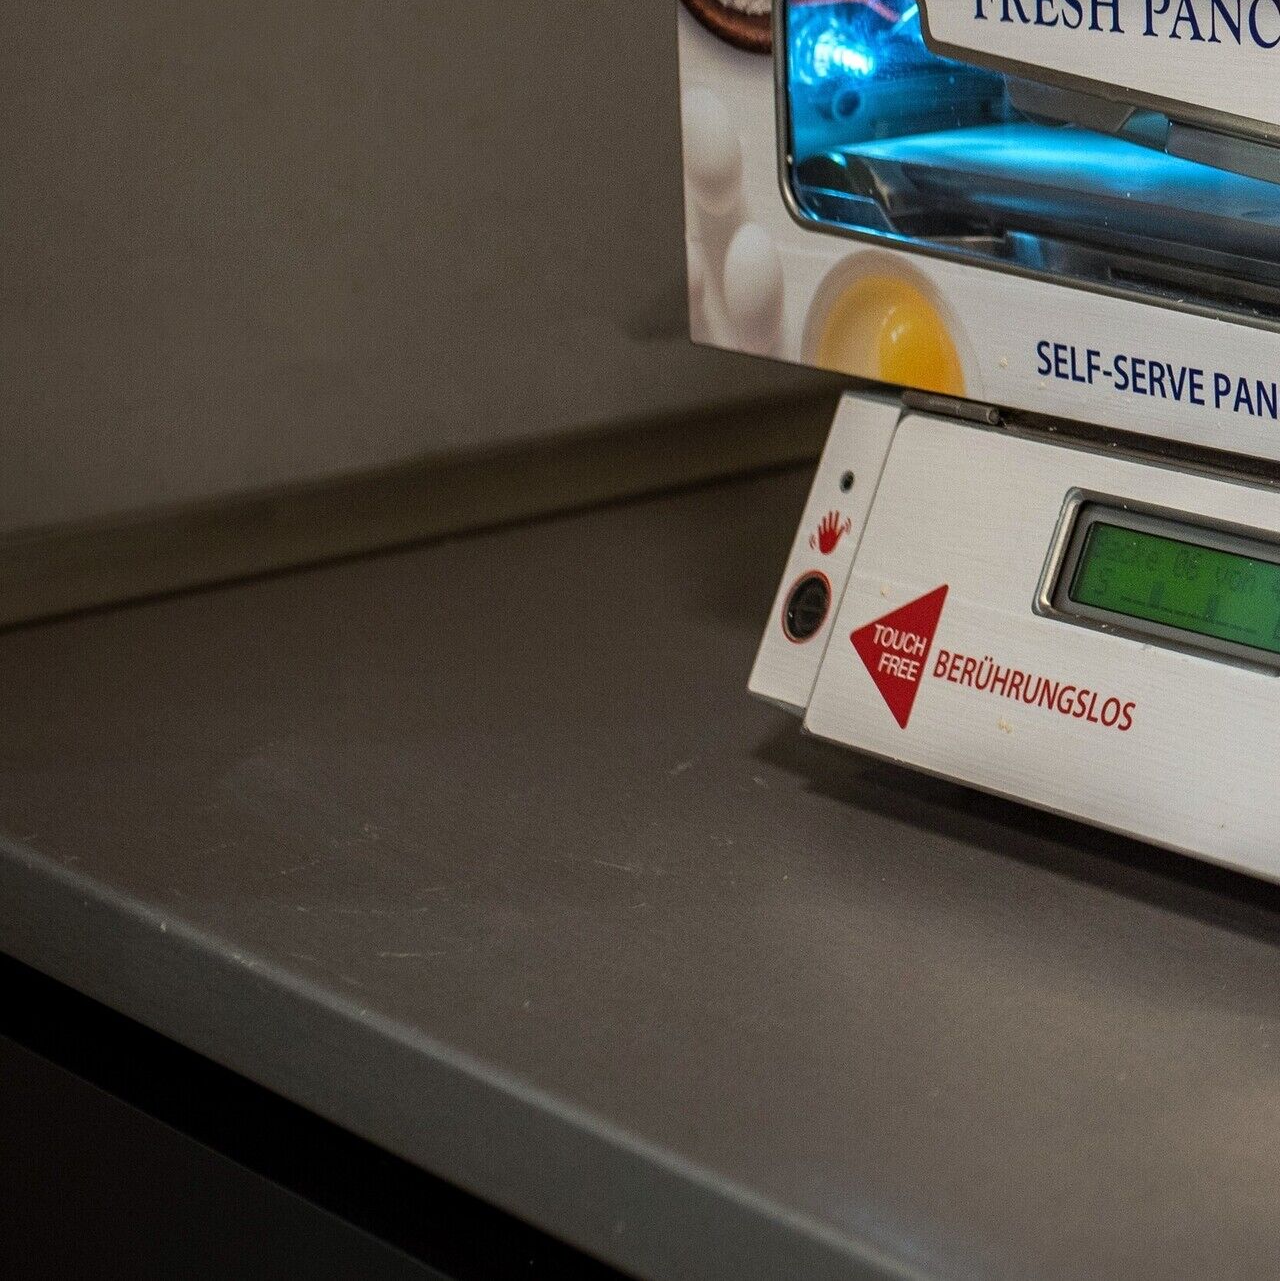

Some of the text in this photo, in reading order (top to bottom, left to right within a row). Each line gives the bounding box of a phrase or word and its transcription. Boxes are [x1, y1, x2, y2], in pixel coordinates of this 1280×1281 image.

[1036, 340, 1205, 406] SELF-SERVE
[873, 624, 927, 657] TOUCH
[878, 653, 919, 682] FREE
[933, 649, 1136, 731] BERÜHRUNGSLOS
